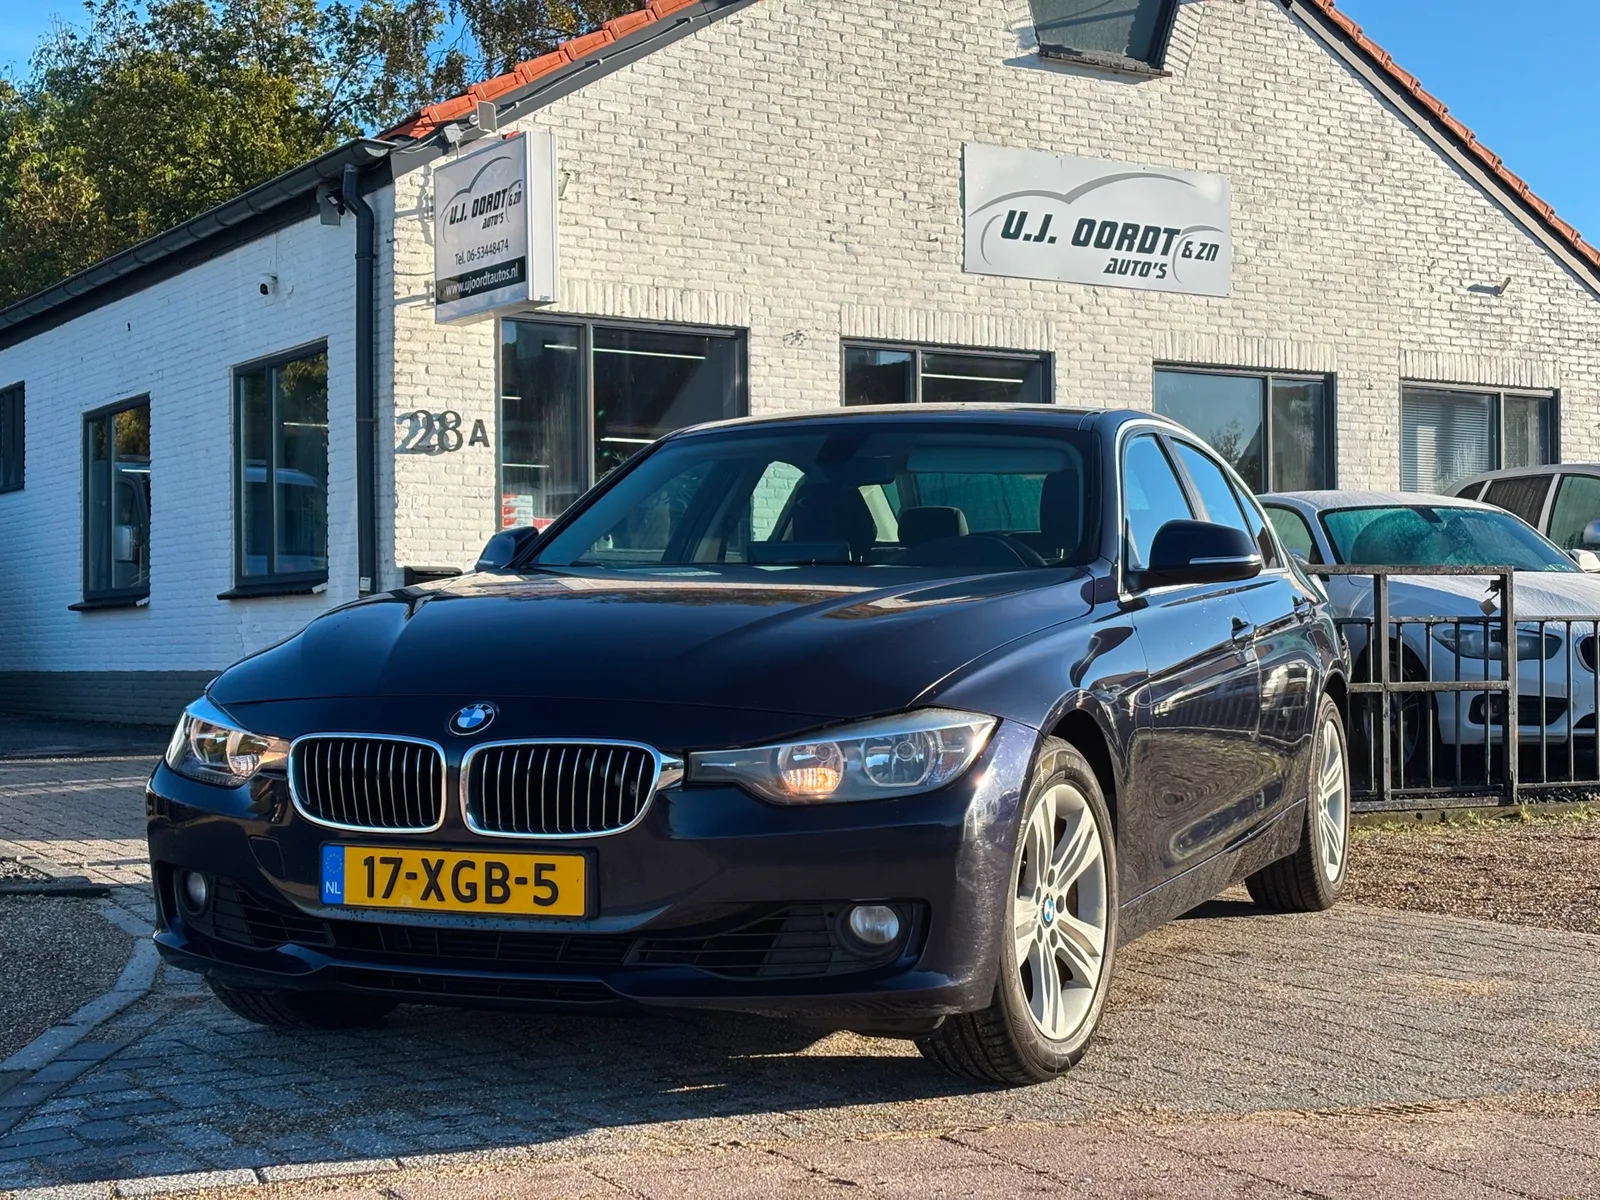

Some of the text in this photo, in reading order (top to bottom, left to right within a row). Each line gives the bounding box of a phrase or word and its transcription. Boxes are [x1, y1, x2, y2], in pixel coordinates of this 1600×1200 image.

[449, 203, 467, 225] U.J.
[472, 188, 507, 218] OORDT
[455, 238, 509, 266] Tel. 06-53448474
[1001, 210, 1057, 244] U.J.
[1071, 218, 1181, 256] OORDT
[1181, 241, 1193, 258] &
[445, 262, 518, 297] www.ujoordtautos.nl
[1103, 258, 1167, 279] AUTO'S
[325, 856, 559, 907] NL 17-XGB-5
